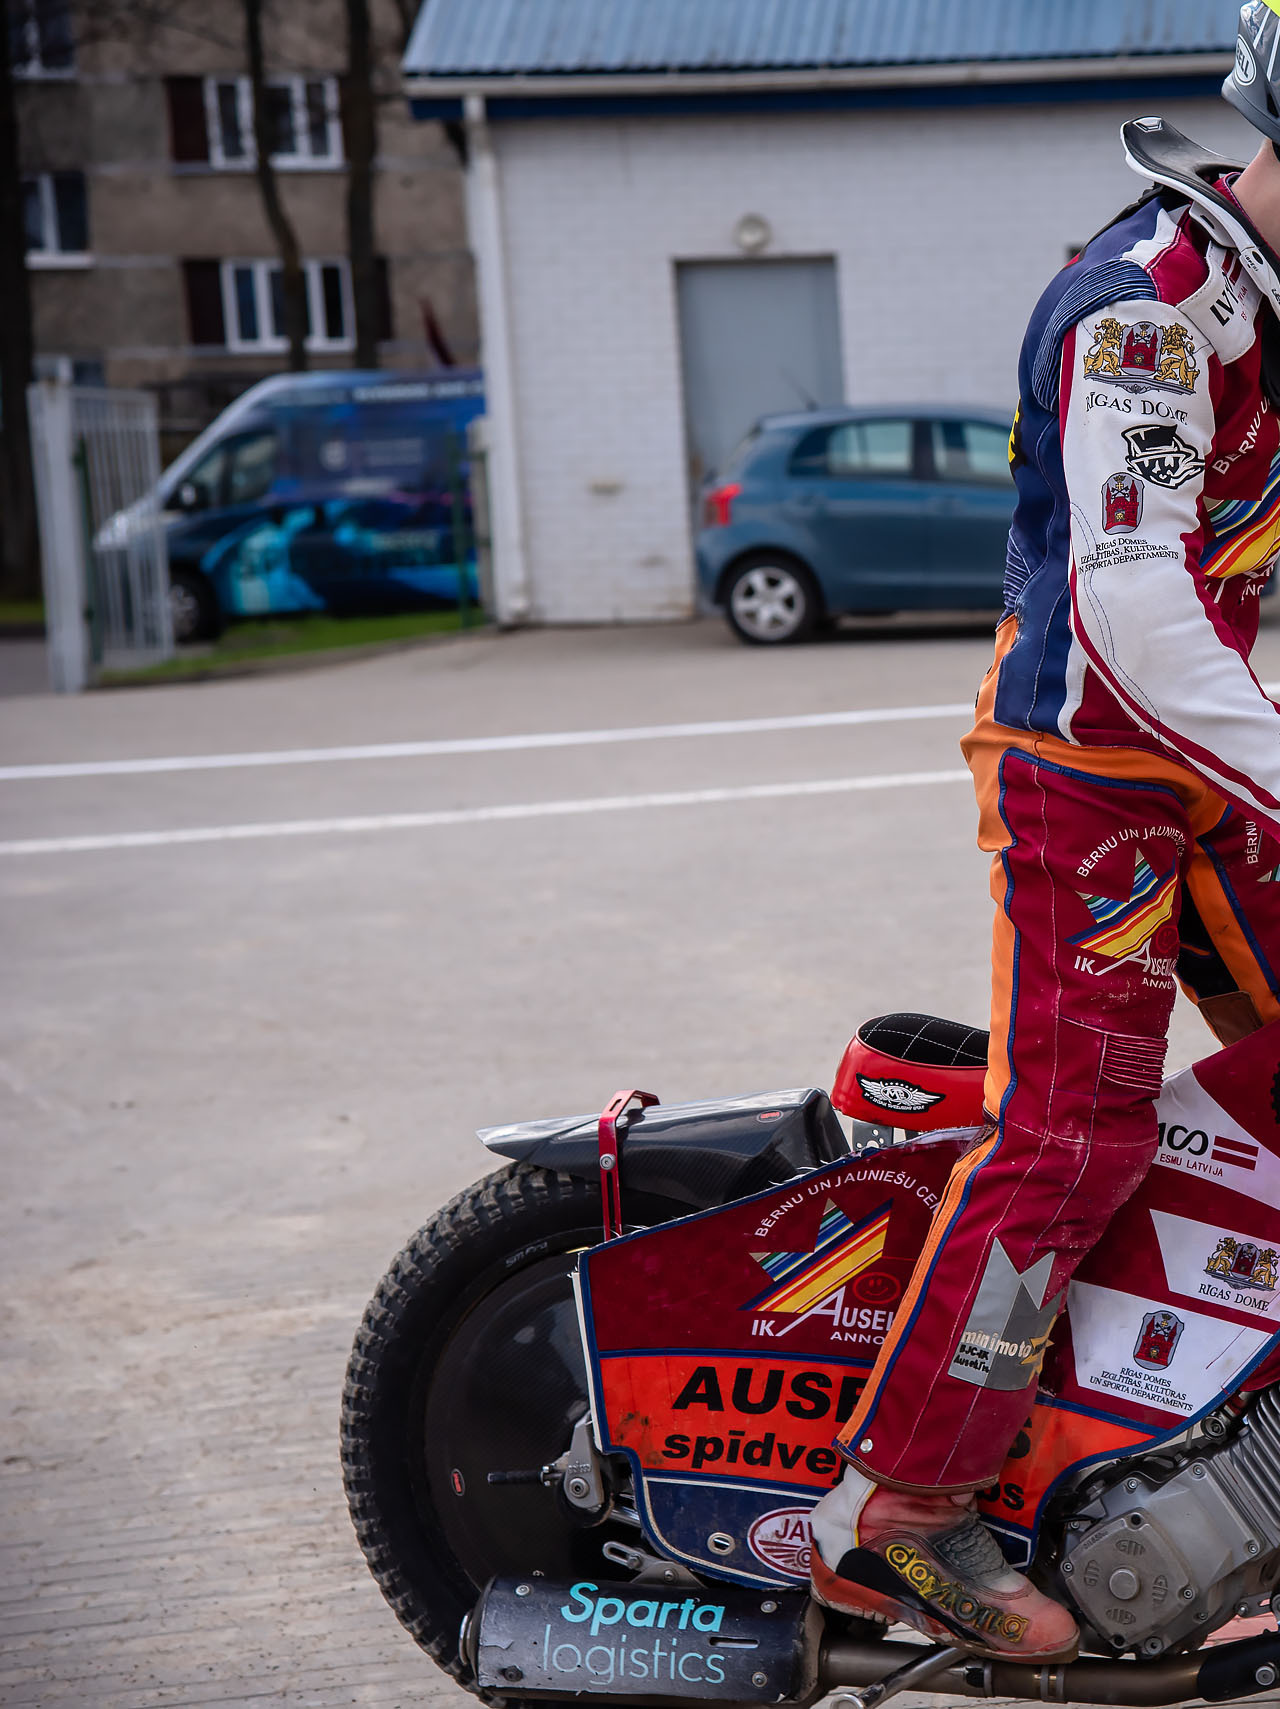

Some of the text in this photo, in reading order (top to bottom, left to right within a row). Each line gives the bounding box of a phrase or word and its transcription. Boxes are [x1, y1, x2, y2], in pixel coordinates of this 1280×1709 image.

[1119, 828, 1139, 841] UN
[1074, 955, 1095, 975] IK
[1160, 1153, 1223, 1177] ESMU LATVIJA
[755, 1193, 804, 1238] BĒRNU
[807, 1178, 831, 1196] UN
[834, 1169, 917, 1190] JAUNIEŠU
[1234, 1293, 1270, 1312] DOME
[751, 1319, 776, 1337] IK
[829, 1331, 885, 1346] ANNO
[961, 1329, 1032, 1358] minimoto
[1143, 1373, 1172, 1388] DOMES
[1089, 1375, 1194, 1412] UN SPORTA DEPARTAMENTS
[561, 1582, 725, 1637] Sparta
[543, 1624, 726, 1685] logistics
